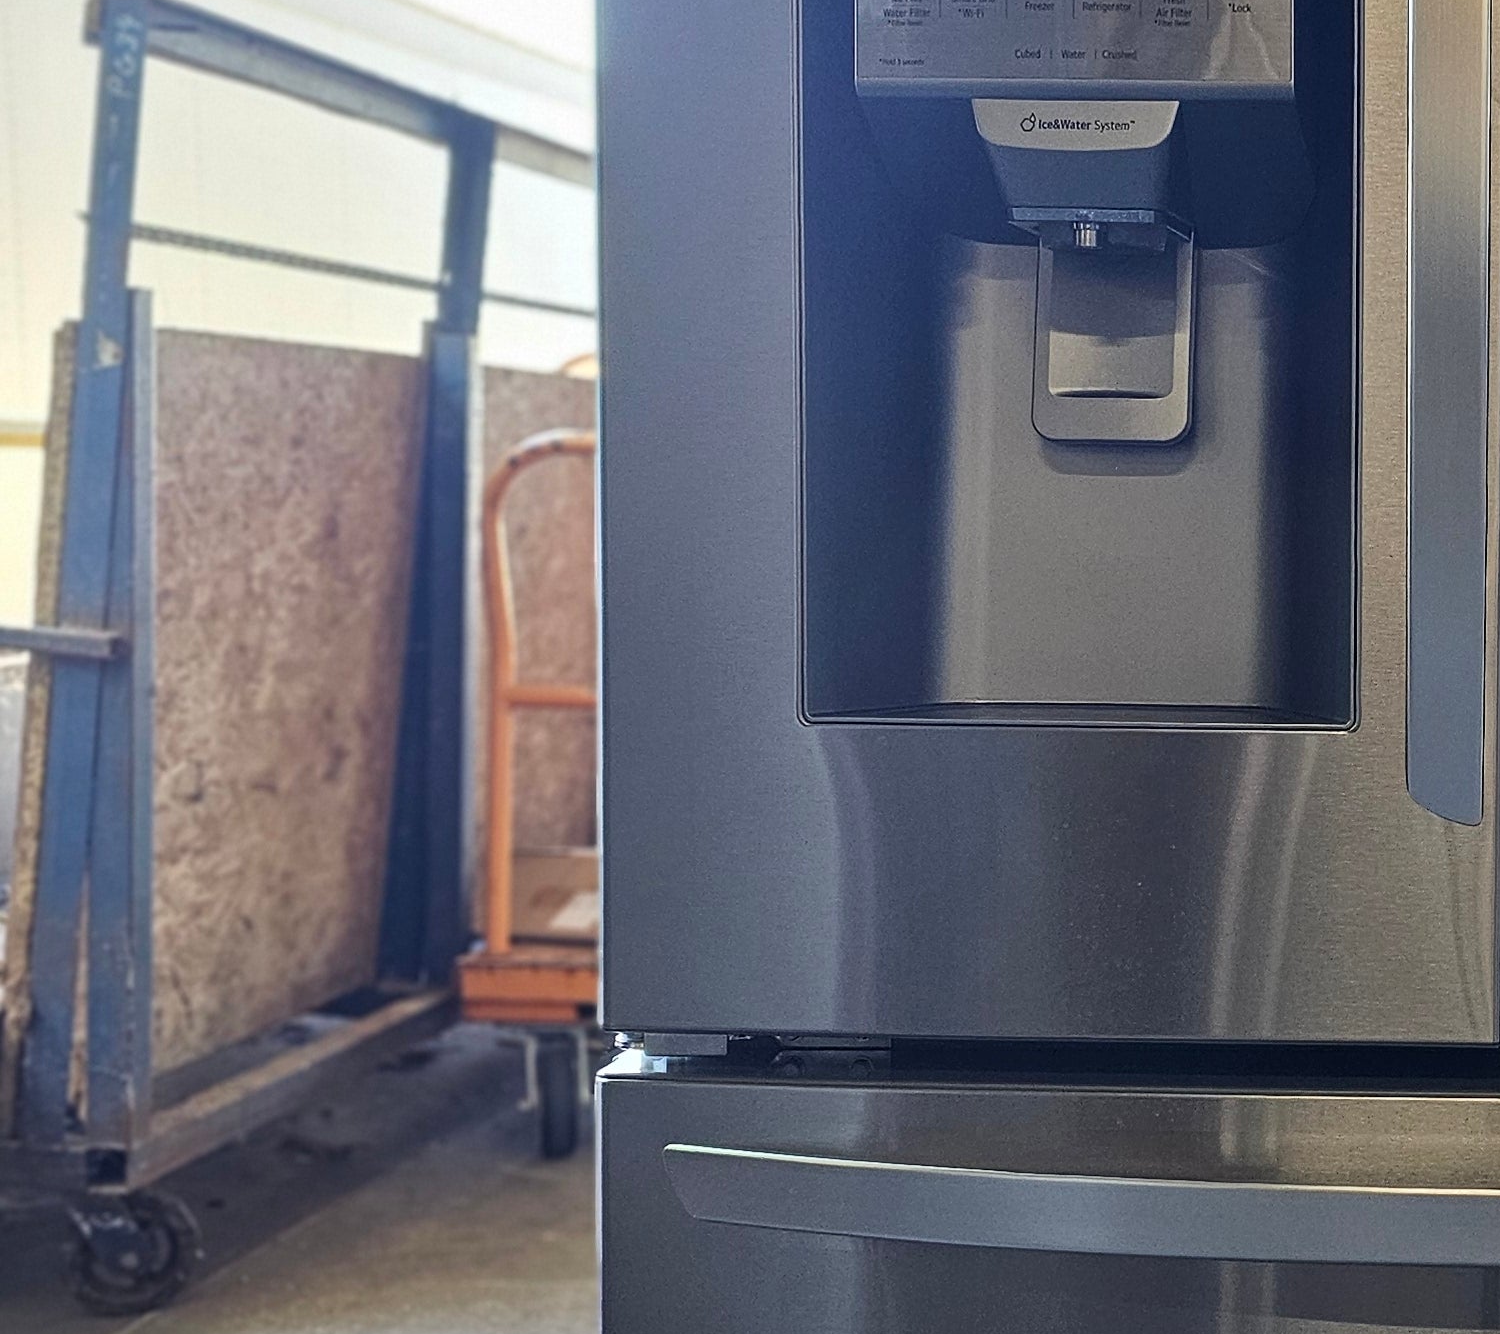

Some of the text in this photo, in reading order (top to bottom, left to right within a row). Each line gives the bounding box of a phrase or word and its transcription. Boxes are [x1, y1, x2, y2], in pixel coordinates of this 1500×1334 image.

[1024, 0, 1055, 12] Freezer
[1082, 0, 1132, 13] Refrigerator
[1014, 49, 1041, 59] Cubed
[1060, 49, 1087, 59] Water
[1102, 49, 1137, 60] Crushed
[1038, 119, 1091, 131] Ice&Water
